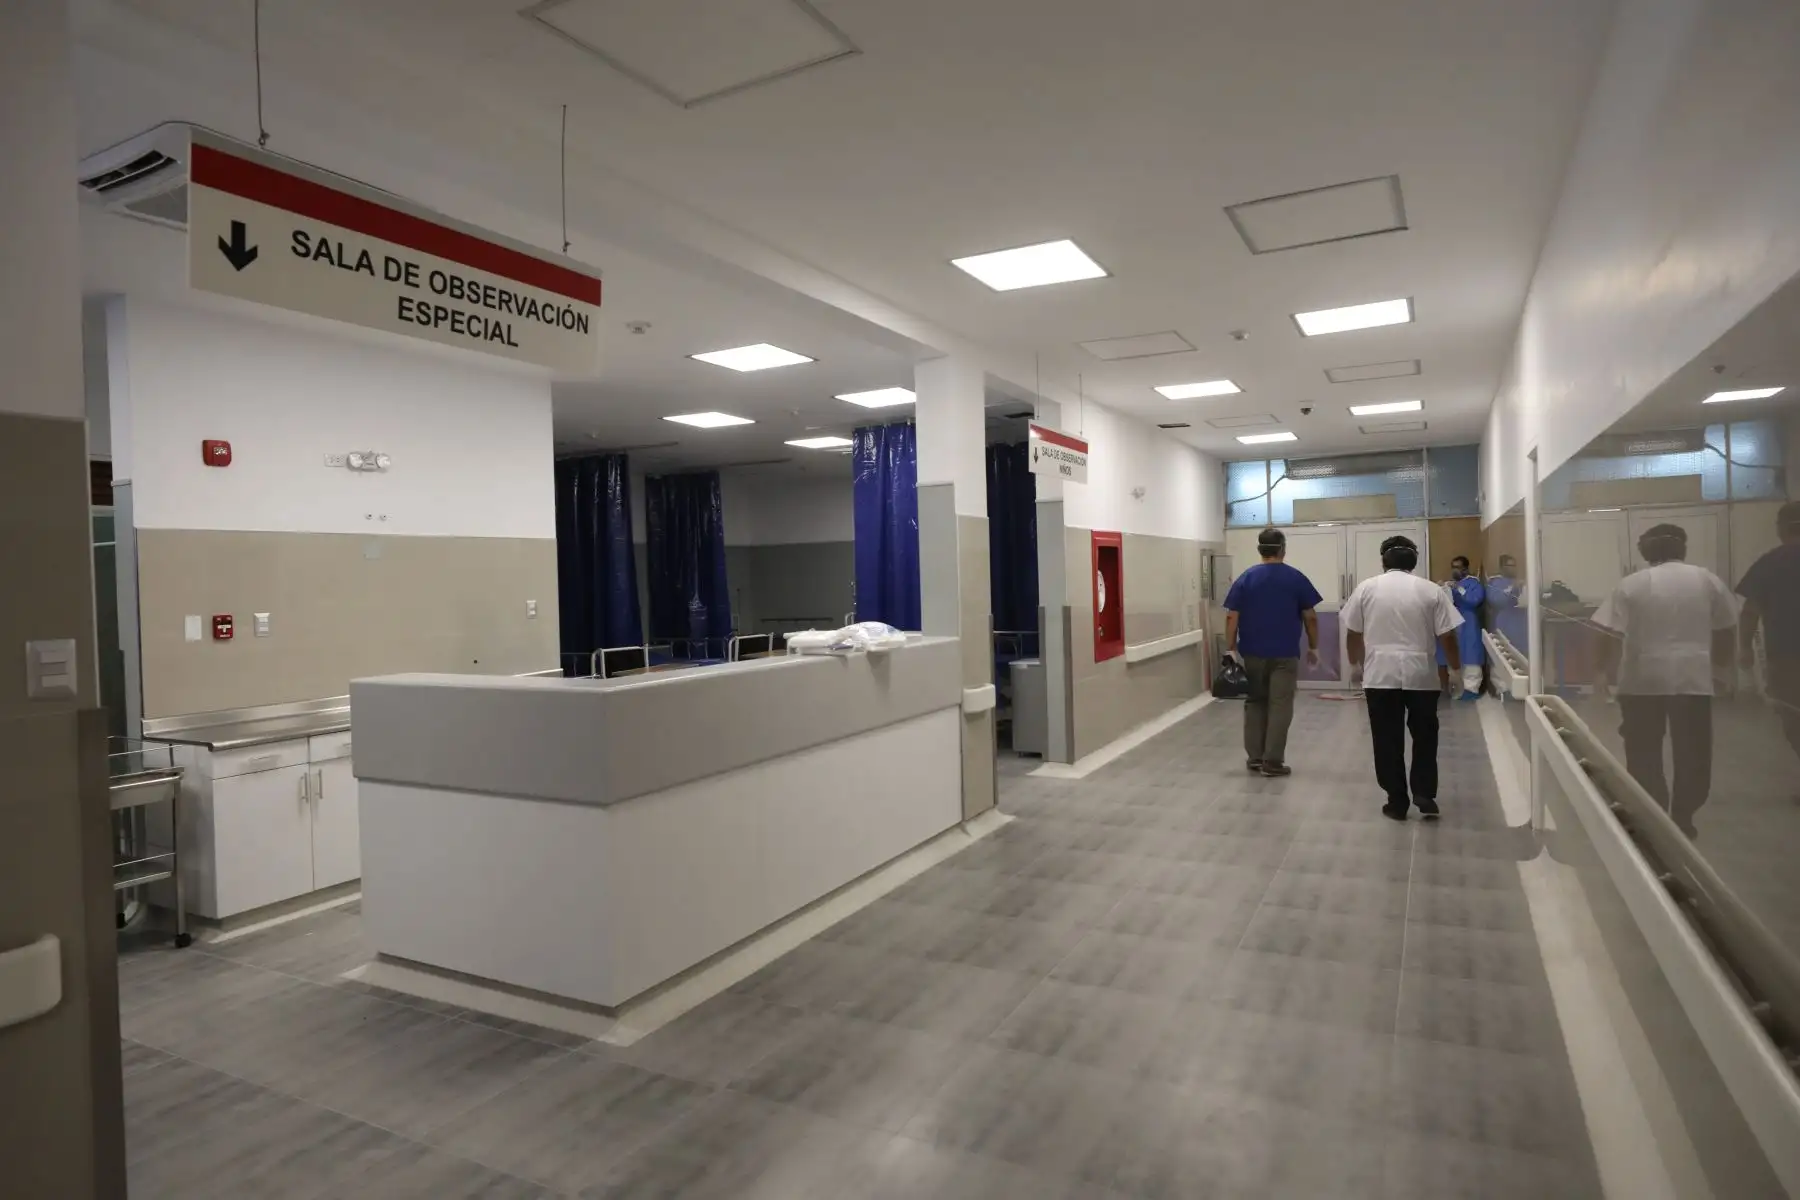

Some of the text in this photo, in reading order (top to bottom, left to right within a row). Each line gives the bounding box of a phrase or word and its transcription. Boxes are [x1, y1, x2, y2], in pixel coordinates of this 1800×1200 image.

[290, 229, 590, 335] SALA DE OBSERVACIÓN
[397, 295, 520, 348] ESPECIAL
[1041, 446, 1054, 459] SALA
[1053, 449, 1060, 460] DE
